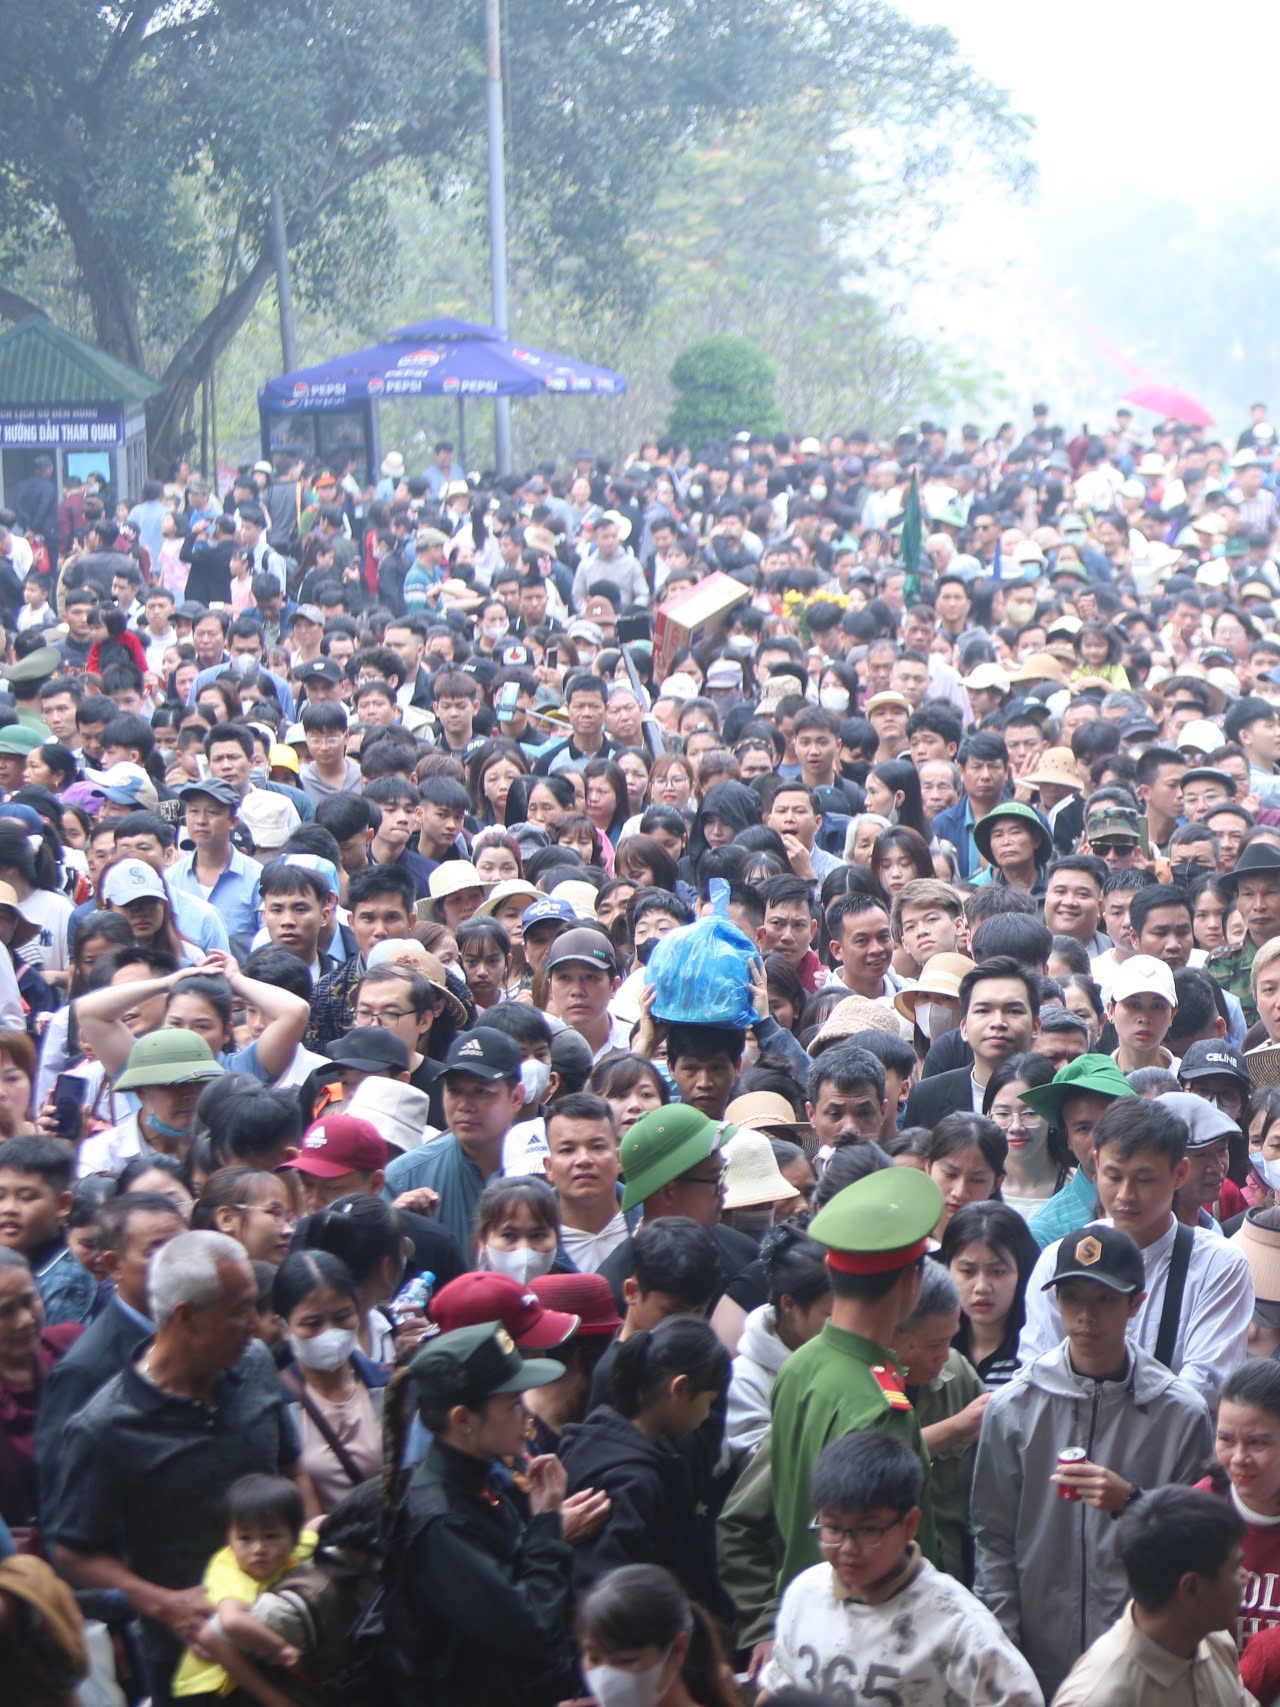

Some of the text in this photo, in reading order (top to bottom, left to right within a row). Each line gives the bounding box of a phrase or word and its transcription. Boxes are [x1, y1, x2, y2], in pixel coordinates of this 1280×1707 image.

[311, 383, 346, 397] PEPSI
[386, 380, 422, 393] PEPSI
[461, 380, 498, 393] PEPSI
[4, 421, 37, 442] HƯỚNG
[39, 419, 60, 442] DẪN
[61, 423, 88, 442] THAM
[90, 423, 117, 443] QUAN
[458, 1049, 484, 1057] adidas
[1205, 1052, 1238, 1068] CELINE
[798, 1644, 906, 1707] 365
